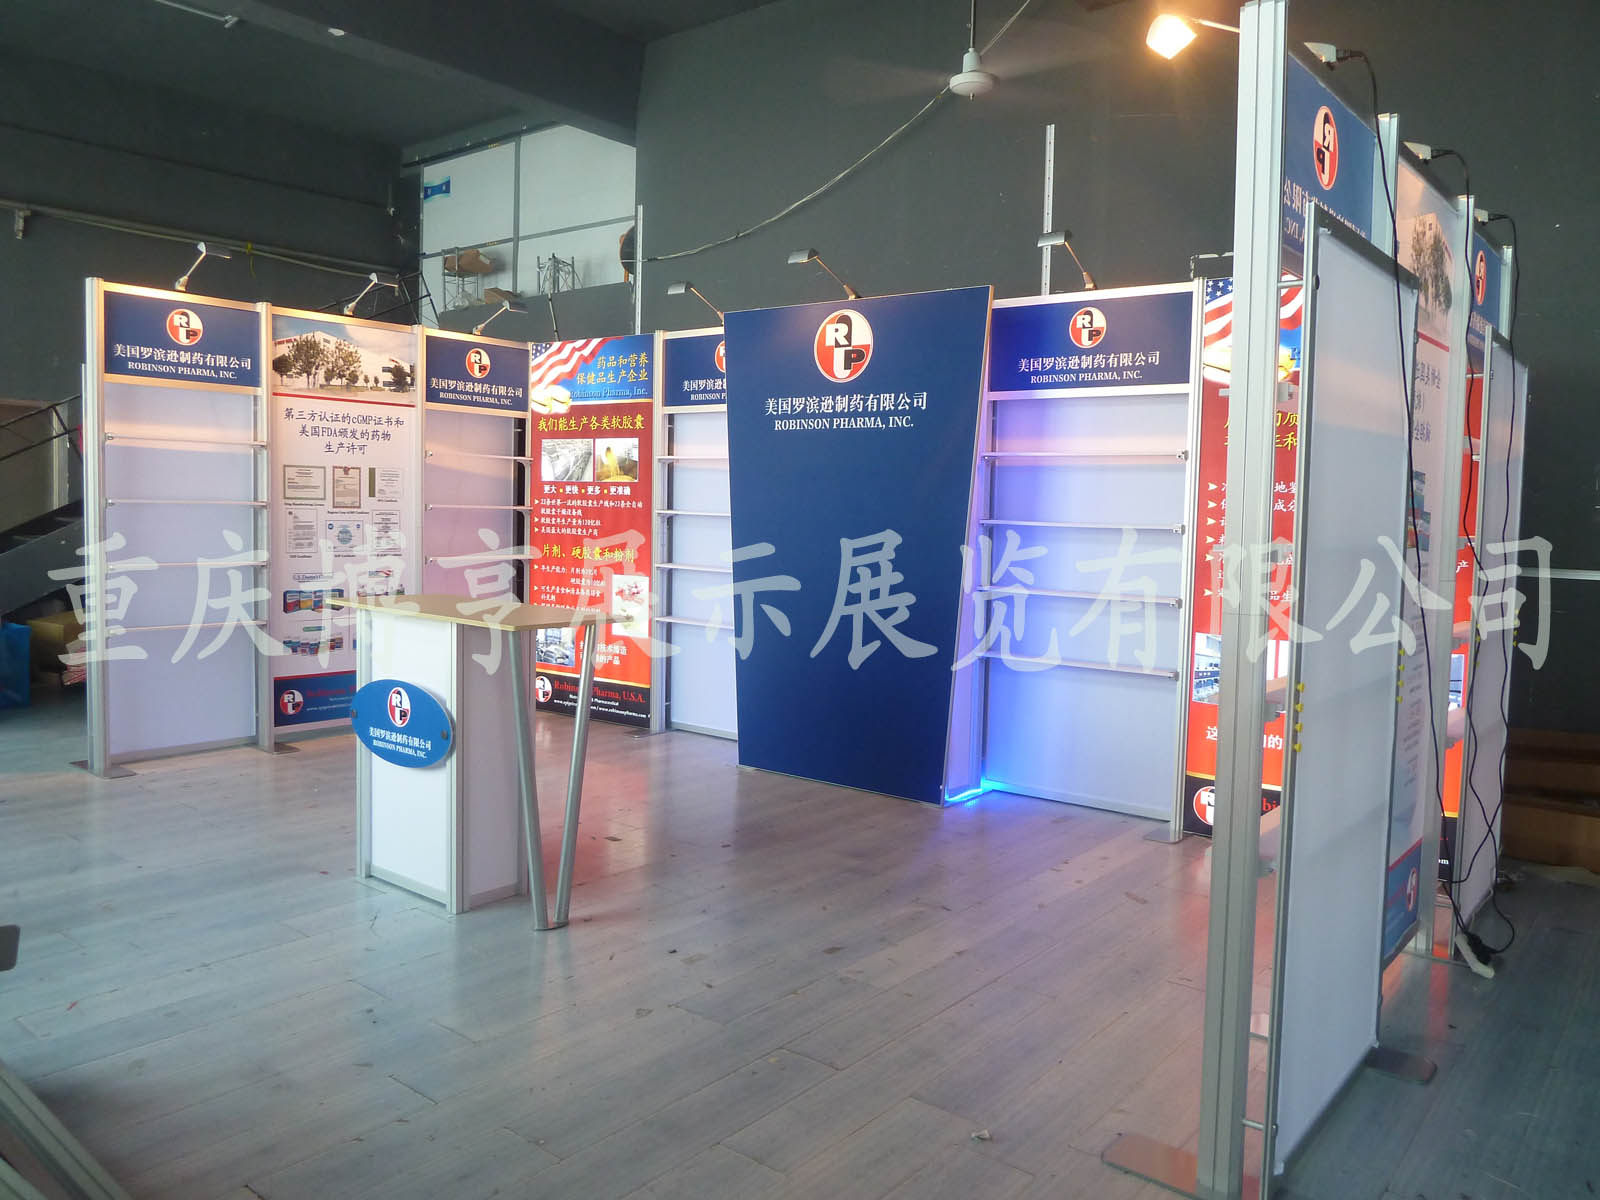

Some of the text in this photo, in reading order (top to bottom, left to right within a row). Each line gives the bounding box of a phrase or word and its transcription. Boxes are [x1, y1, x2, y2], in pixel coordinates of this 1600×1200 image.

[113, 343, 252, 371] 美国罗滨逊制药有限公司
[596, 352, 649, 369] 药品和营养
[1018, 351, 1160, 373] 美国罗滨逊制药有限公司
[128, 361, 238, 379] ROBINSON PHARMA, INC.
[576, 368, 649, 385] 保健品生产企业
[1030, 369, 1143, 384] ROBINSON PHARMA, INC.
[430, 377, 523, 398] 美国罗滨逊制药有限公司
[602, 387, 633, 398] Pharma,
[634, 386, 648, 396] Inc.
[439, 392, 513, 406] ROBINSON PHARMA, INC.
[690, 392, 721, 401] ROBINSON
[764, 391, 928, 416] 美国罗滨逊制药有限公司
[283, 406, 405, 428] 第三方认证的cGMP证书和
[537, 413, 645, 432] 我们能生产各类软胶囊
[774, 416, 914, 431] ROBINSON PHARMA, INC.
[299, 423, 392, 442] 美国FDA颁发的药物
[323, 441, 368, 455] 生产许可
[543, 484, 557, 494] 更大
[586, 485, 601, 495] 更多
